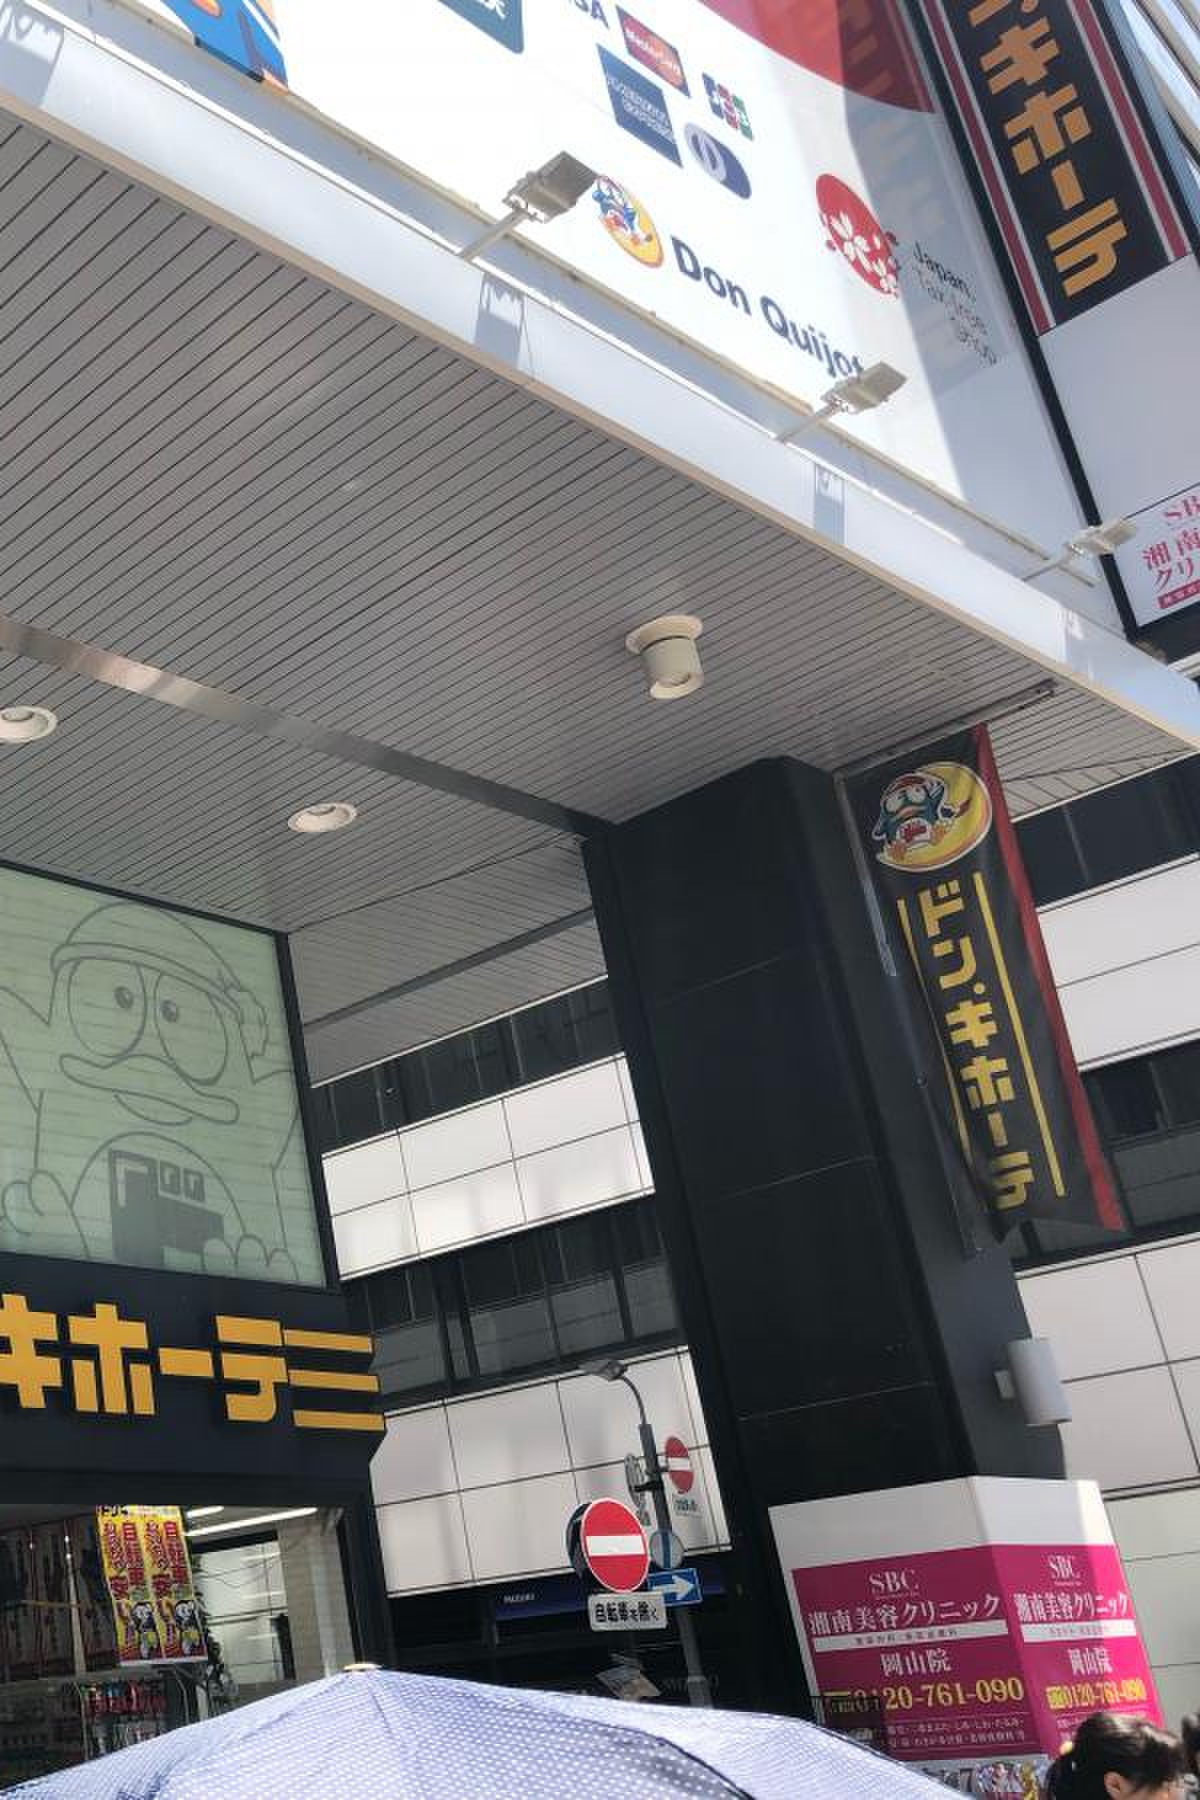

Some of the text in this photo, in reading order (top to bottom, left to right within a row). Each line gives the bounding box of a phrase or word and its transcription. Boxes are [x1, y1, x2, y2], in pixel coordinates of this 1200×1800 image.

[671, 235, 864, 378] Don Quijot
[868, 1569, 920, 1595] SBC
[1048, 1555, 1081, 1579] SBC
[808, 1593, 1001, 1636] 湘南美容クリニック
[1013, 1591, 1128, 1623] 湘南美容クリニック
[880, 1648, 952, 1677] 岡山院
